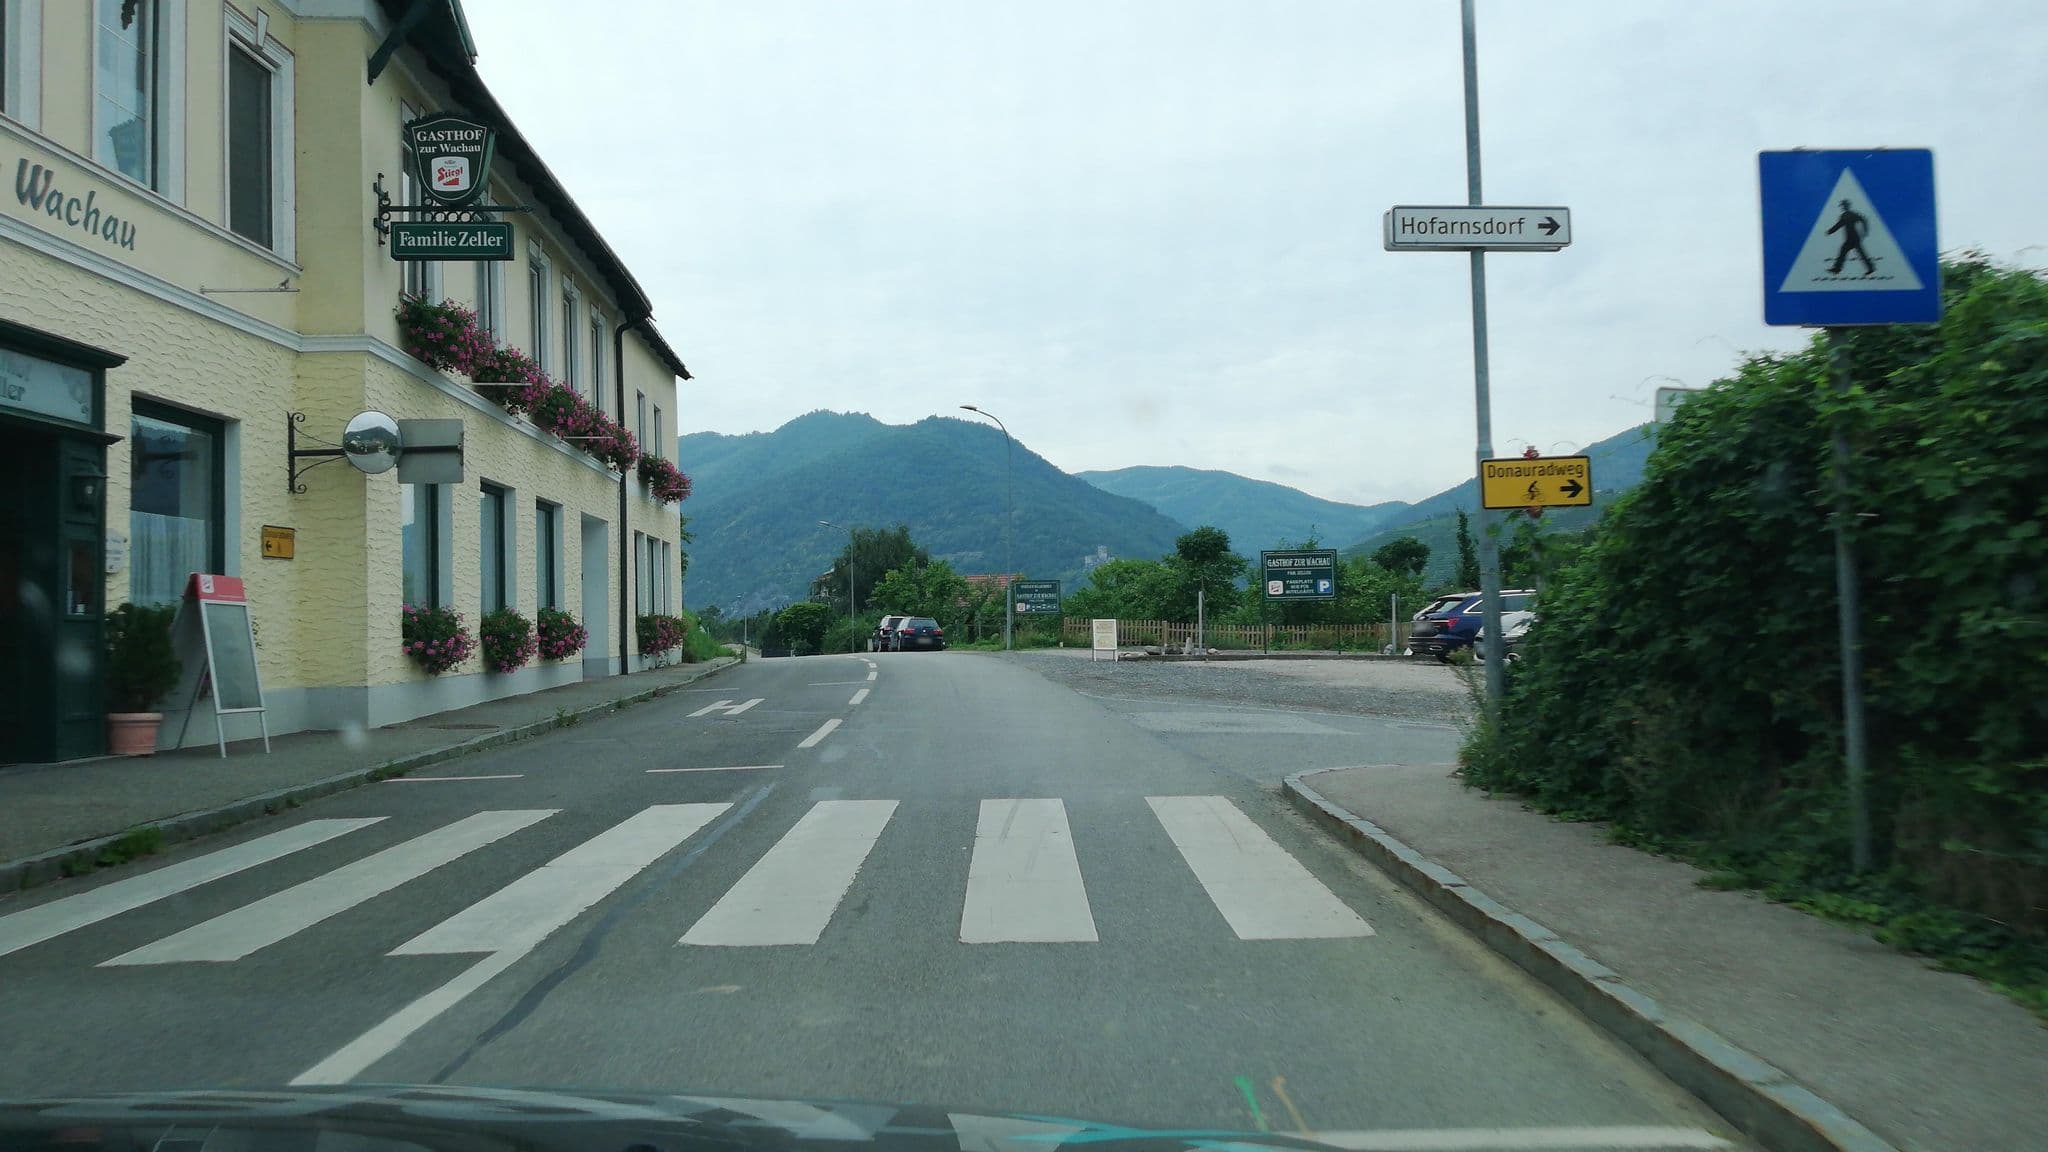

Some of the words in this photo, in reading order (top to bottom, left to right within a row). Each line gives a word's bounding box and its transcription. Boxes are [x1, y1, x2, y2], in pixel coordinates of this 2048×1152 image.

[416, 129, 484, 142] GASTHOF
[419, 145, 437, 154] zur
[439, 143, 481, 153] Wachau
[15, 157, 137, 251] Wachau
[1401, 216, 1526, 235] Hofarnsdorf
[399, 231, 457, 247] Familie
[458, 231, 504, 247] Zeller
[1487, 462, 1584, 478] Donauradweg
[1267, 558, 1293, 567] GASTHOF
[1293, 558, 1306, 567] ZUR
[1306, 556, 1331, 566] WACHAU
[1319, 580, 1330, 592] P
